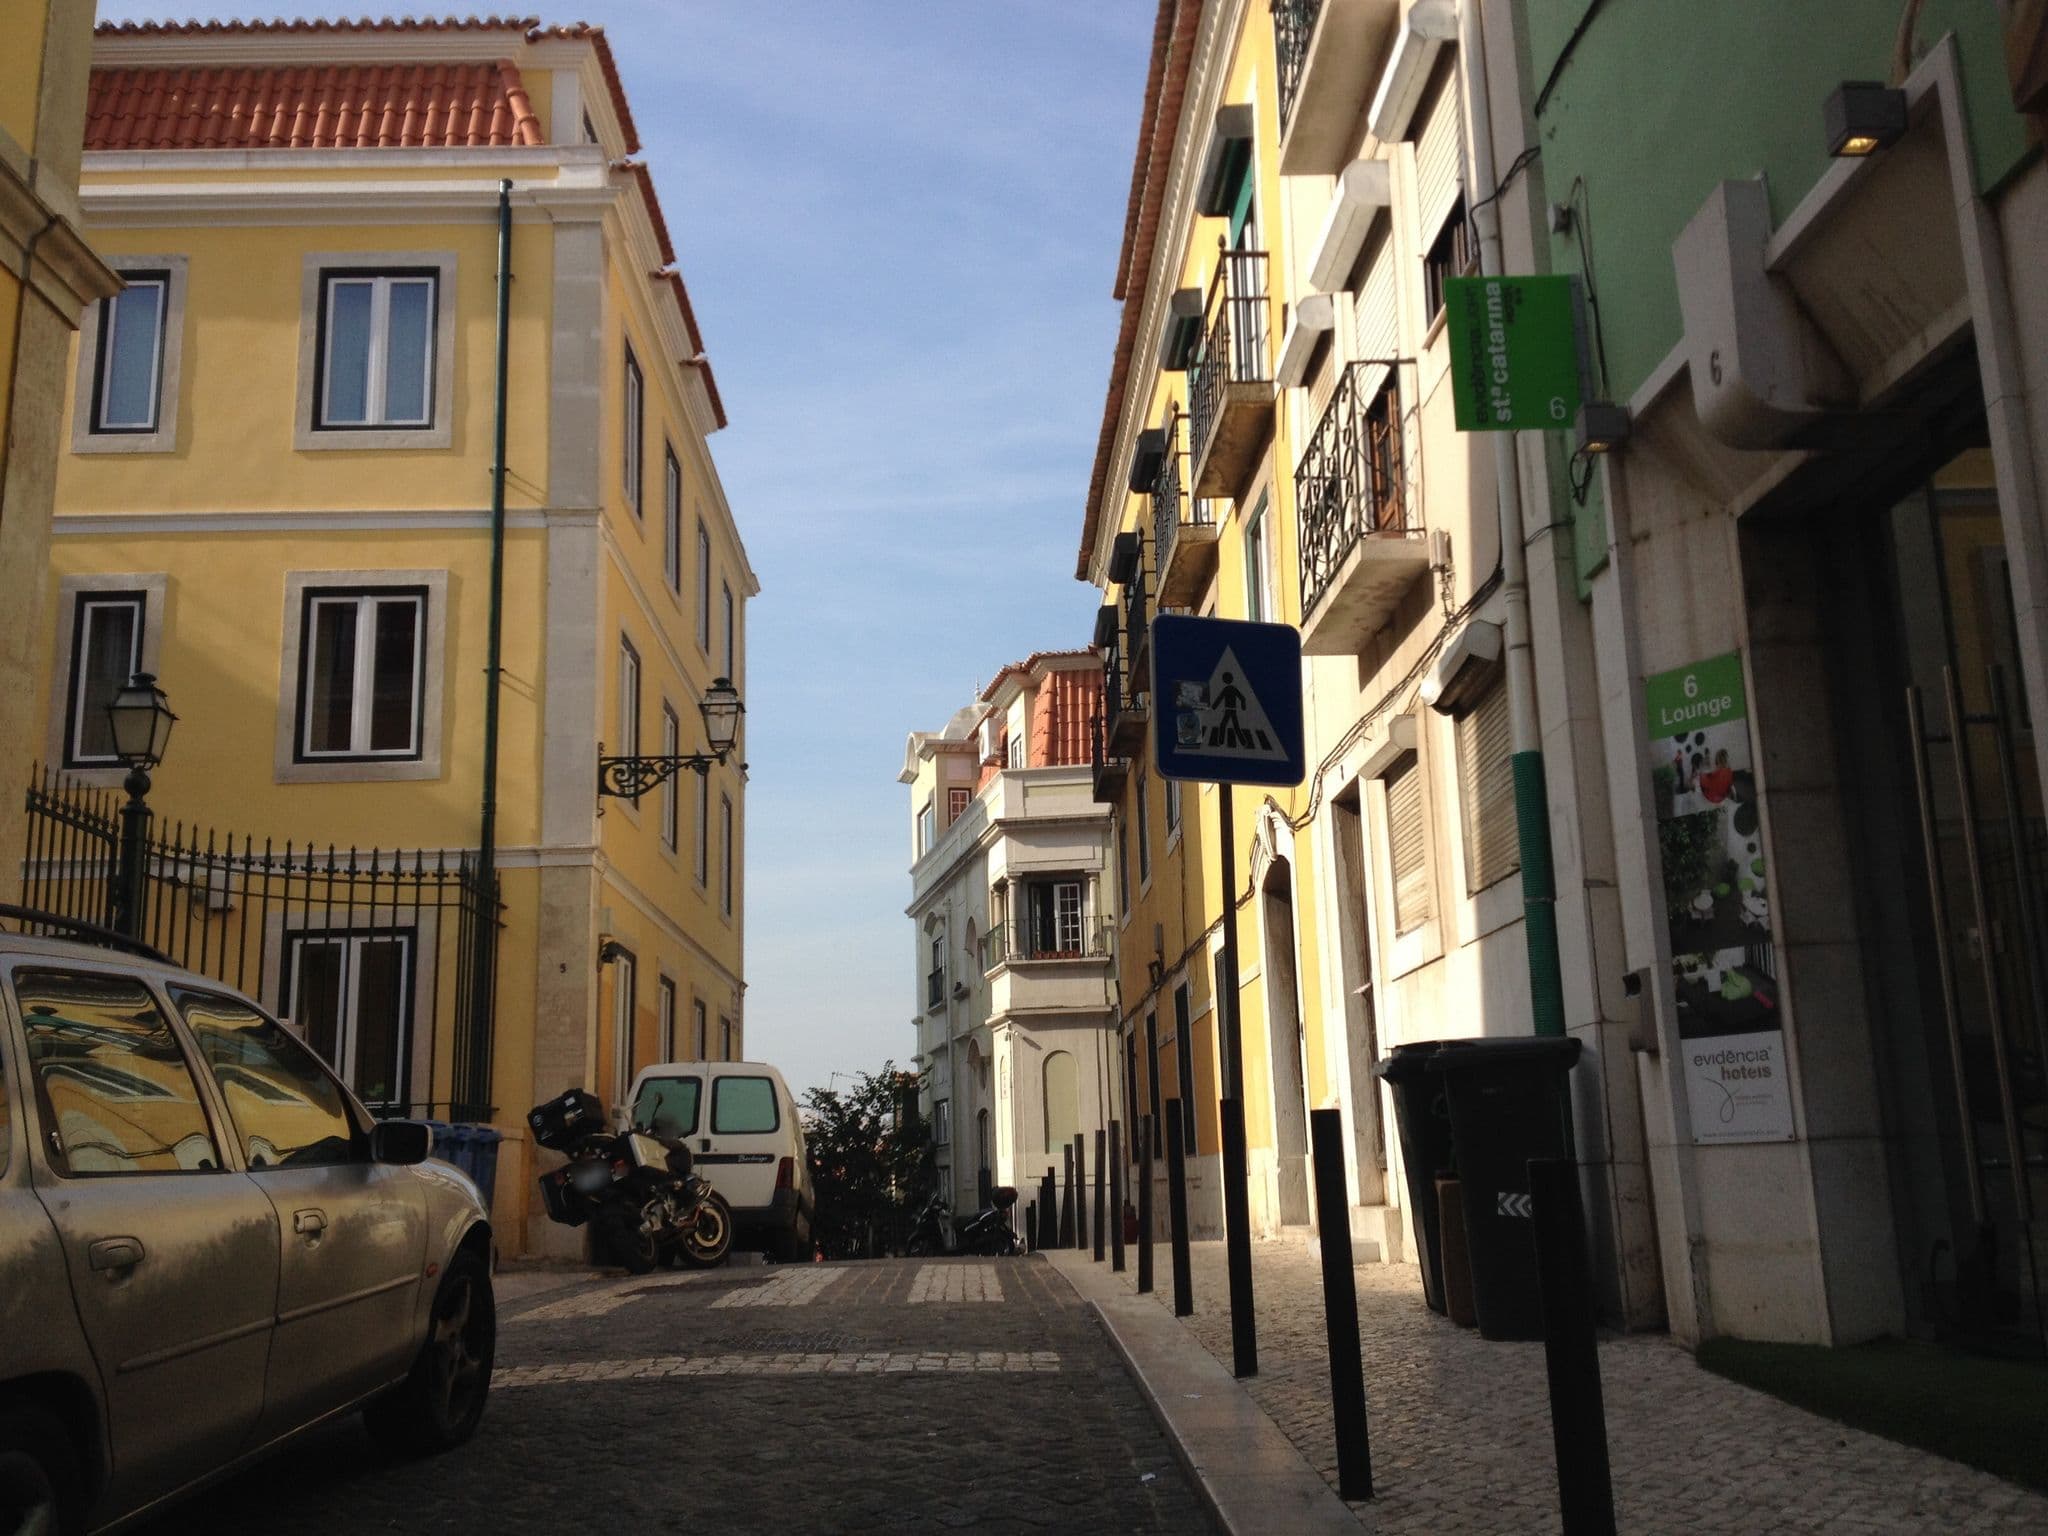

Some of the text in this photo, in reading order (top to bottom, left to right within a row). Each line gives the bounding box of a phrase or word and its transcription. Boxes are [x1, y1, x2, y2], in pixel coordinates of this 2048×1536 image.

[1486, 282, 1508, 384] catarina
[1710, 350, 1722, 386] 6
[1550, 396, 1566, 420] 6
[1684, 674, 1697, 698] 6
[1662, 696, 1732, 726] Lounge
[1693, 1048, 1770, 1067] evidência
[1721, 1065, 1772, 1081] hotels
